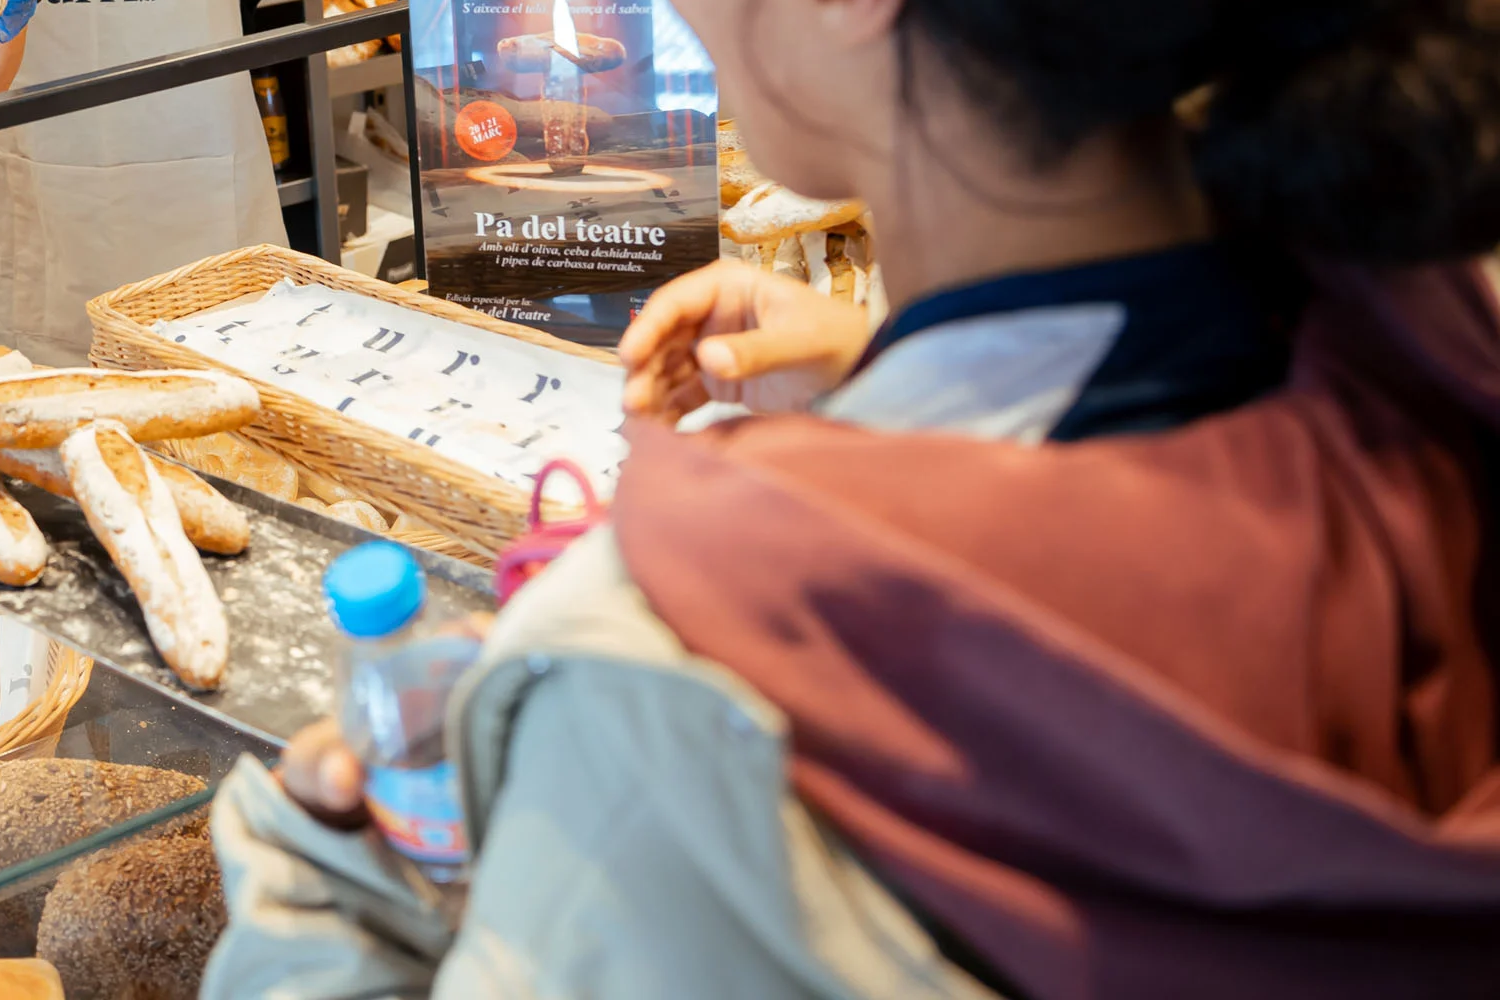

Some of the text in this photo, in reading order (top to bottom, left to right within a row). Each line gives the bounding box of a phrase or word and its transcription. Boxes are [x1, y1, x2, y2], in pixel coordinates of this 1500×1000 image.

[462, 3, 510, 14] S'aixeca
[512, 3, 523, 14] el
[605, 3, 616, 14] el
[487, 116, 498, 128] 21
[474, 212, 667, 247] Pa del teatre
[479, 241, 663, 262] Amb oli d'oliva, ceba deshidratada
[501, 255, 530, 269] pipes
[531, 255, 545, 267] de
[546, 257, 595, 270] carbassa
[597, 260, 646, 273] torrades.
[445, 293, 471, 304] Edició
[472, 294, 505, 307] especial
[505, 296, 519, 307] per
[488, 307, 508, 320] del
[510, 307, 552, 322] Teatre
